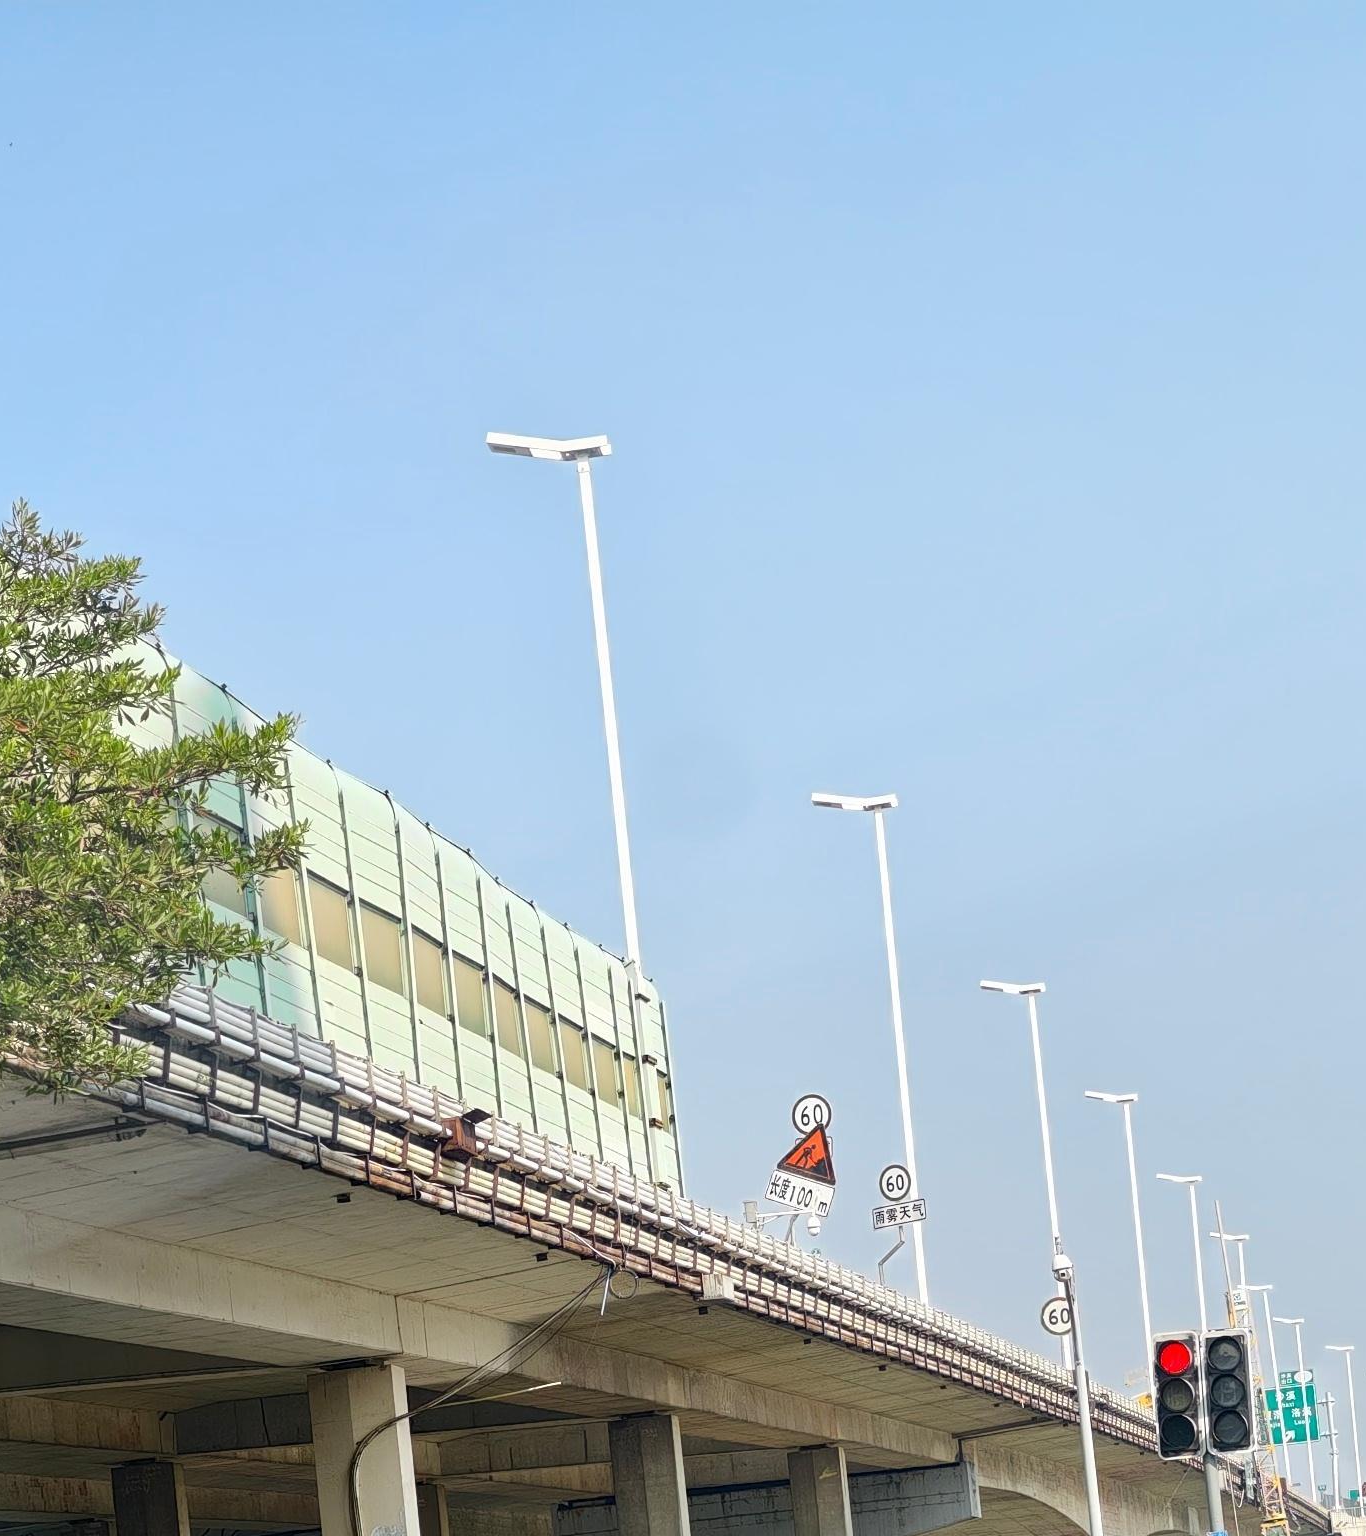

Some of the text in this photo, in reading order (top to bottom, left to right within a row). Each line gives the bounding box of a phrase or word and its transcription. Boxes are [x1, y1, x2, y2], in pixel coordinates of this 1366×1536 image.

[800, 1104, 823, 1126] 60
[886, 1174, 904, 1192] 60
[874, 1203, 924, 1225] 雨雾天气
[1049, 1308, 1070, 1325] 60
